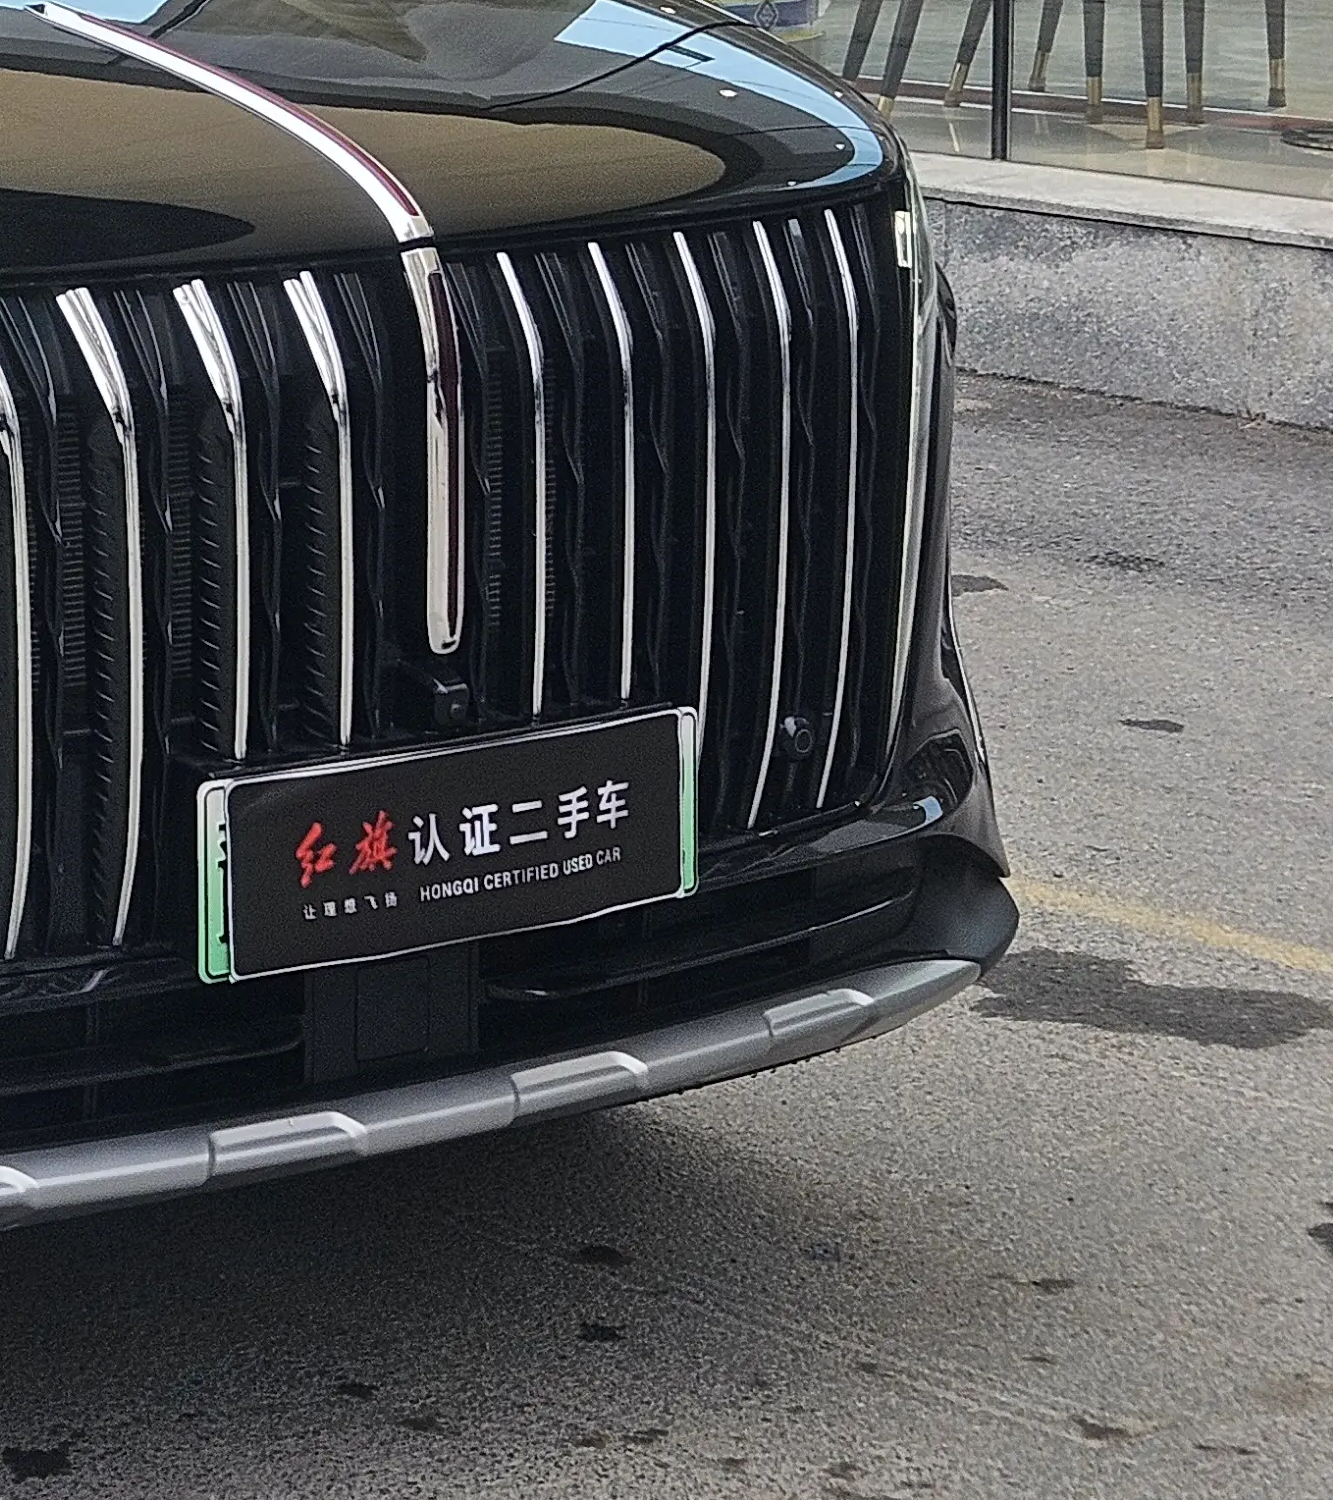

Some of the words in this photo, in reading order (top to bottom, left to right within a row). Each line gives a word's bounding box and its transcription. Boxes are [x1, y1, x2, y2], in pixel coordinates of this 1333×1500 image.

[295, 779, 630, 888] 红旗认证二手车
[419, 876, 479, 902] HONGQI
[483, 862, 559, 891] CERTIFIED
[562, 853, 593, 876] USED
[595, 846, 622, 866] CAR
